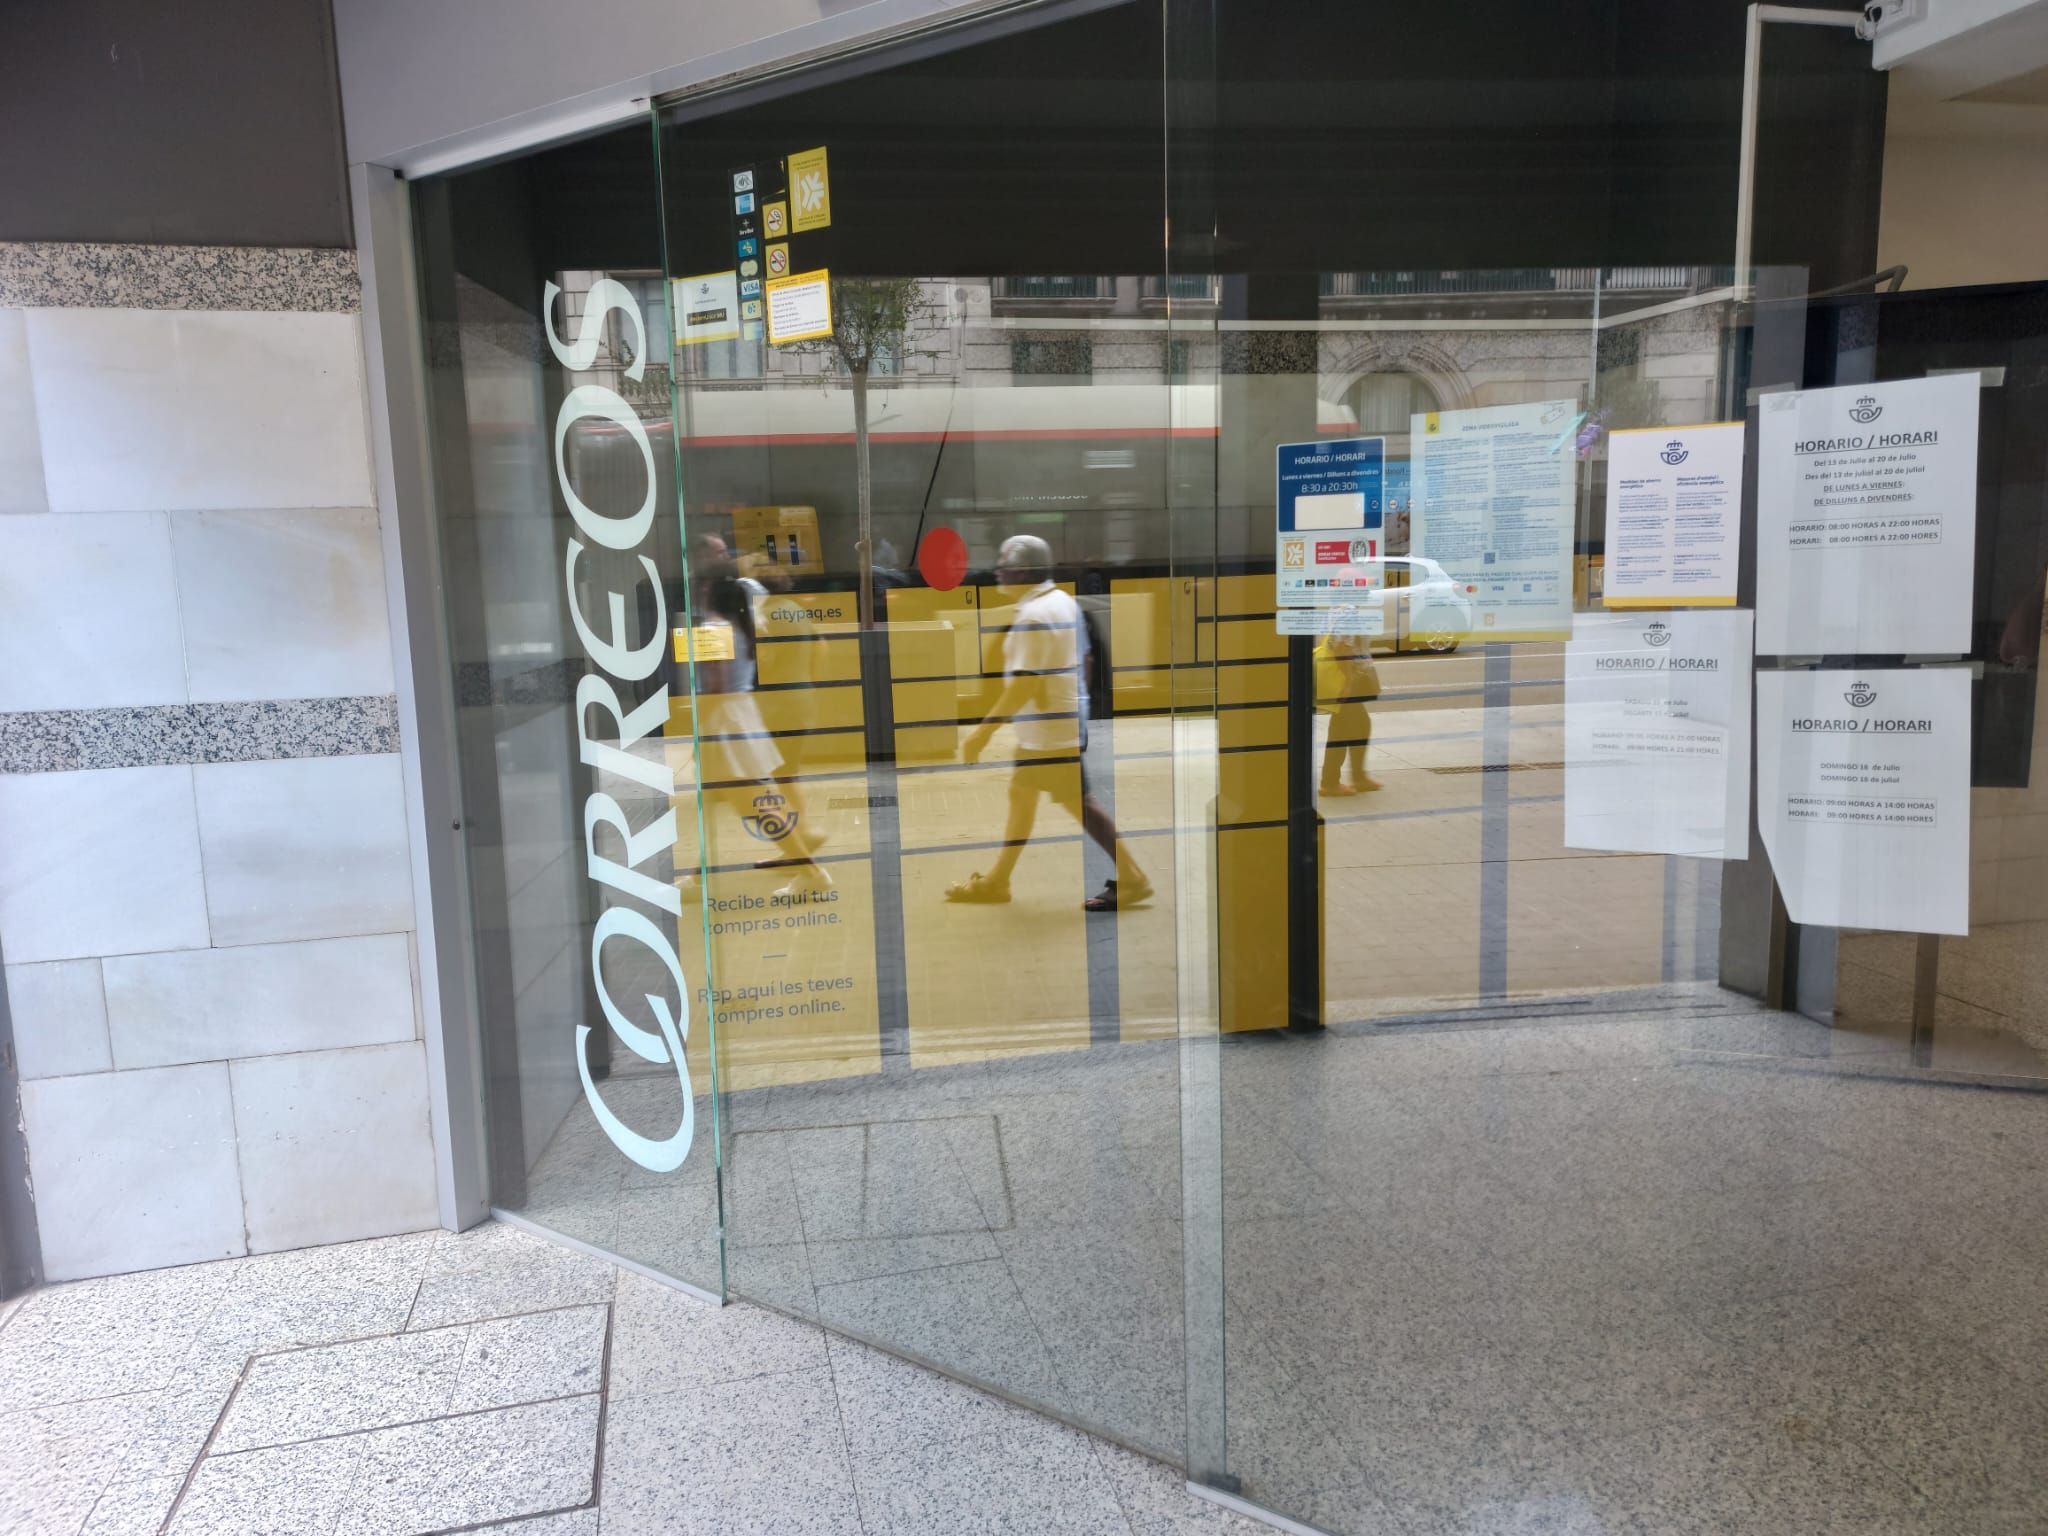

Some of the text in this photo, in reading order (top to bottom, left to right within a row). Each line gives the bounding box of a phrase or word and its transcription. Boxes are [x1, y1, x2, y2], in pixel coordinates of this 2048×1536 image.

[744, 281, 759, 292] VISA
[1794, 430, 1938, 453] HORARIO / HORARI
[1295, 454, 1329, 464] HORARIO
[1335, 452, 1366, 462] HORARI
[1814, 459, 1827, 467] Del
[1877, 455, 1886, 463] 20
[1888, 454, 1897, 462] de
[1899, 453, 1917, 461] Julio
[1820, 471, 1831, 479] del
[1833, 471, 1842, 479] 13
[1843, 470, 1853, 478] de
[1854, 469, 1874, 478] juliol
[1905, 466, 1925, 475] juliol
[1301, 483, 1320, 493] 8:30
[1328, 481, 1358, 492] 20:30h
[1835, 483, 1860, 491] LUNES
[1870, 481, 1904, 489] VIERNES:
[1826, 497, 1858, 505] DILLUNS
[1867, 493, 1914, 502] DIVENDRES:
[1790, 524, 1826, 532] HORARIO:
[1828, 523, 1850, 531] 08:00
[1851, 521, 1879, 529] HORAS
[1888, 520, 1910, 528] 22:00
[1911, 518, 1940, 526] HORAS
[1888, 533, 1909, 541] 22:00
[1911, 532, 1938, 540] HORES
[770, 606, 842, 622] citypaq.es
[1596, 657, 1718, 670] HORARIO / HORARI
[544, 278, 695, 1174] CORREOS
[1792, 718, 1932, 732] HORARIO / HORARI
[1820, 762, 1858, 770] DOMINGO
[1883, 763, 1900, 771] Julio
[1820, 774, 1858, 782] DOMINGO
[1881, 775, 1900, 784] juliol
[1788, 798, 1824, 806] HORARIO:
[1884, 814, 1906, 822] 14:00
[706, 888, 839, 912] Recibe aquí tus
[785, 910, 842, 928] online.
[697, 976, 853, 1005] Rep aquí les teves
[788, 998, 846, 1016] online.
